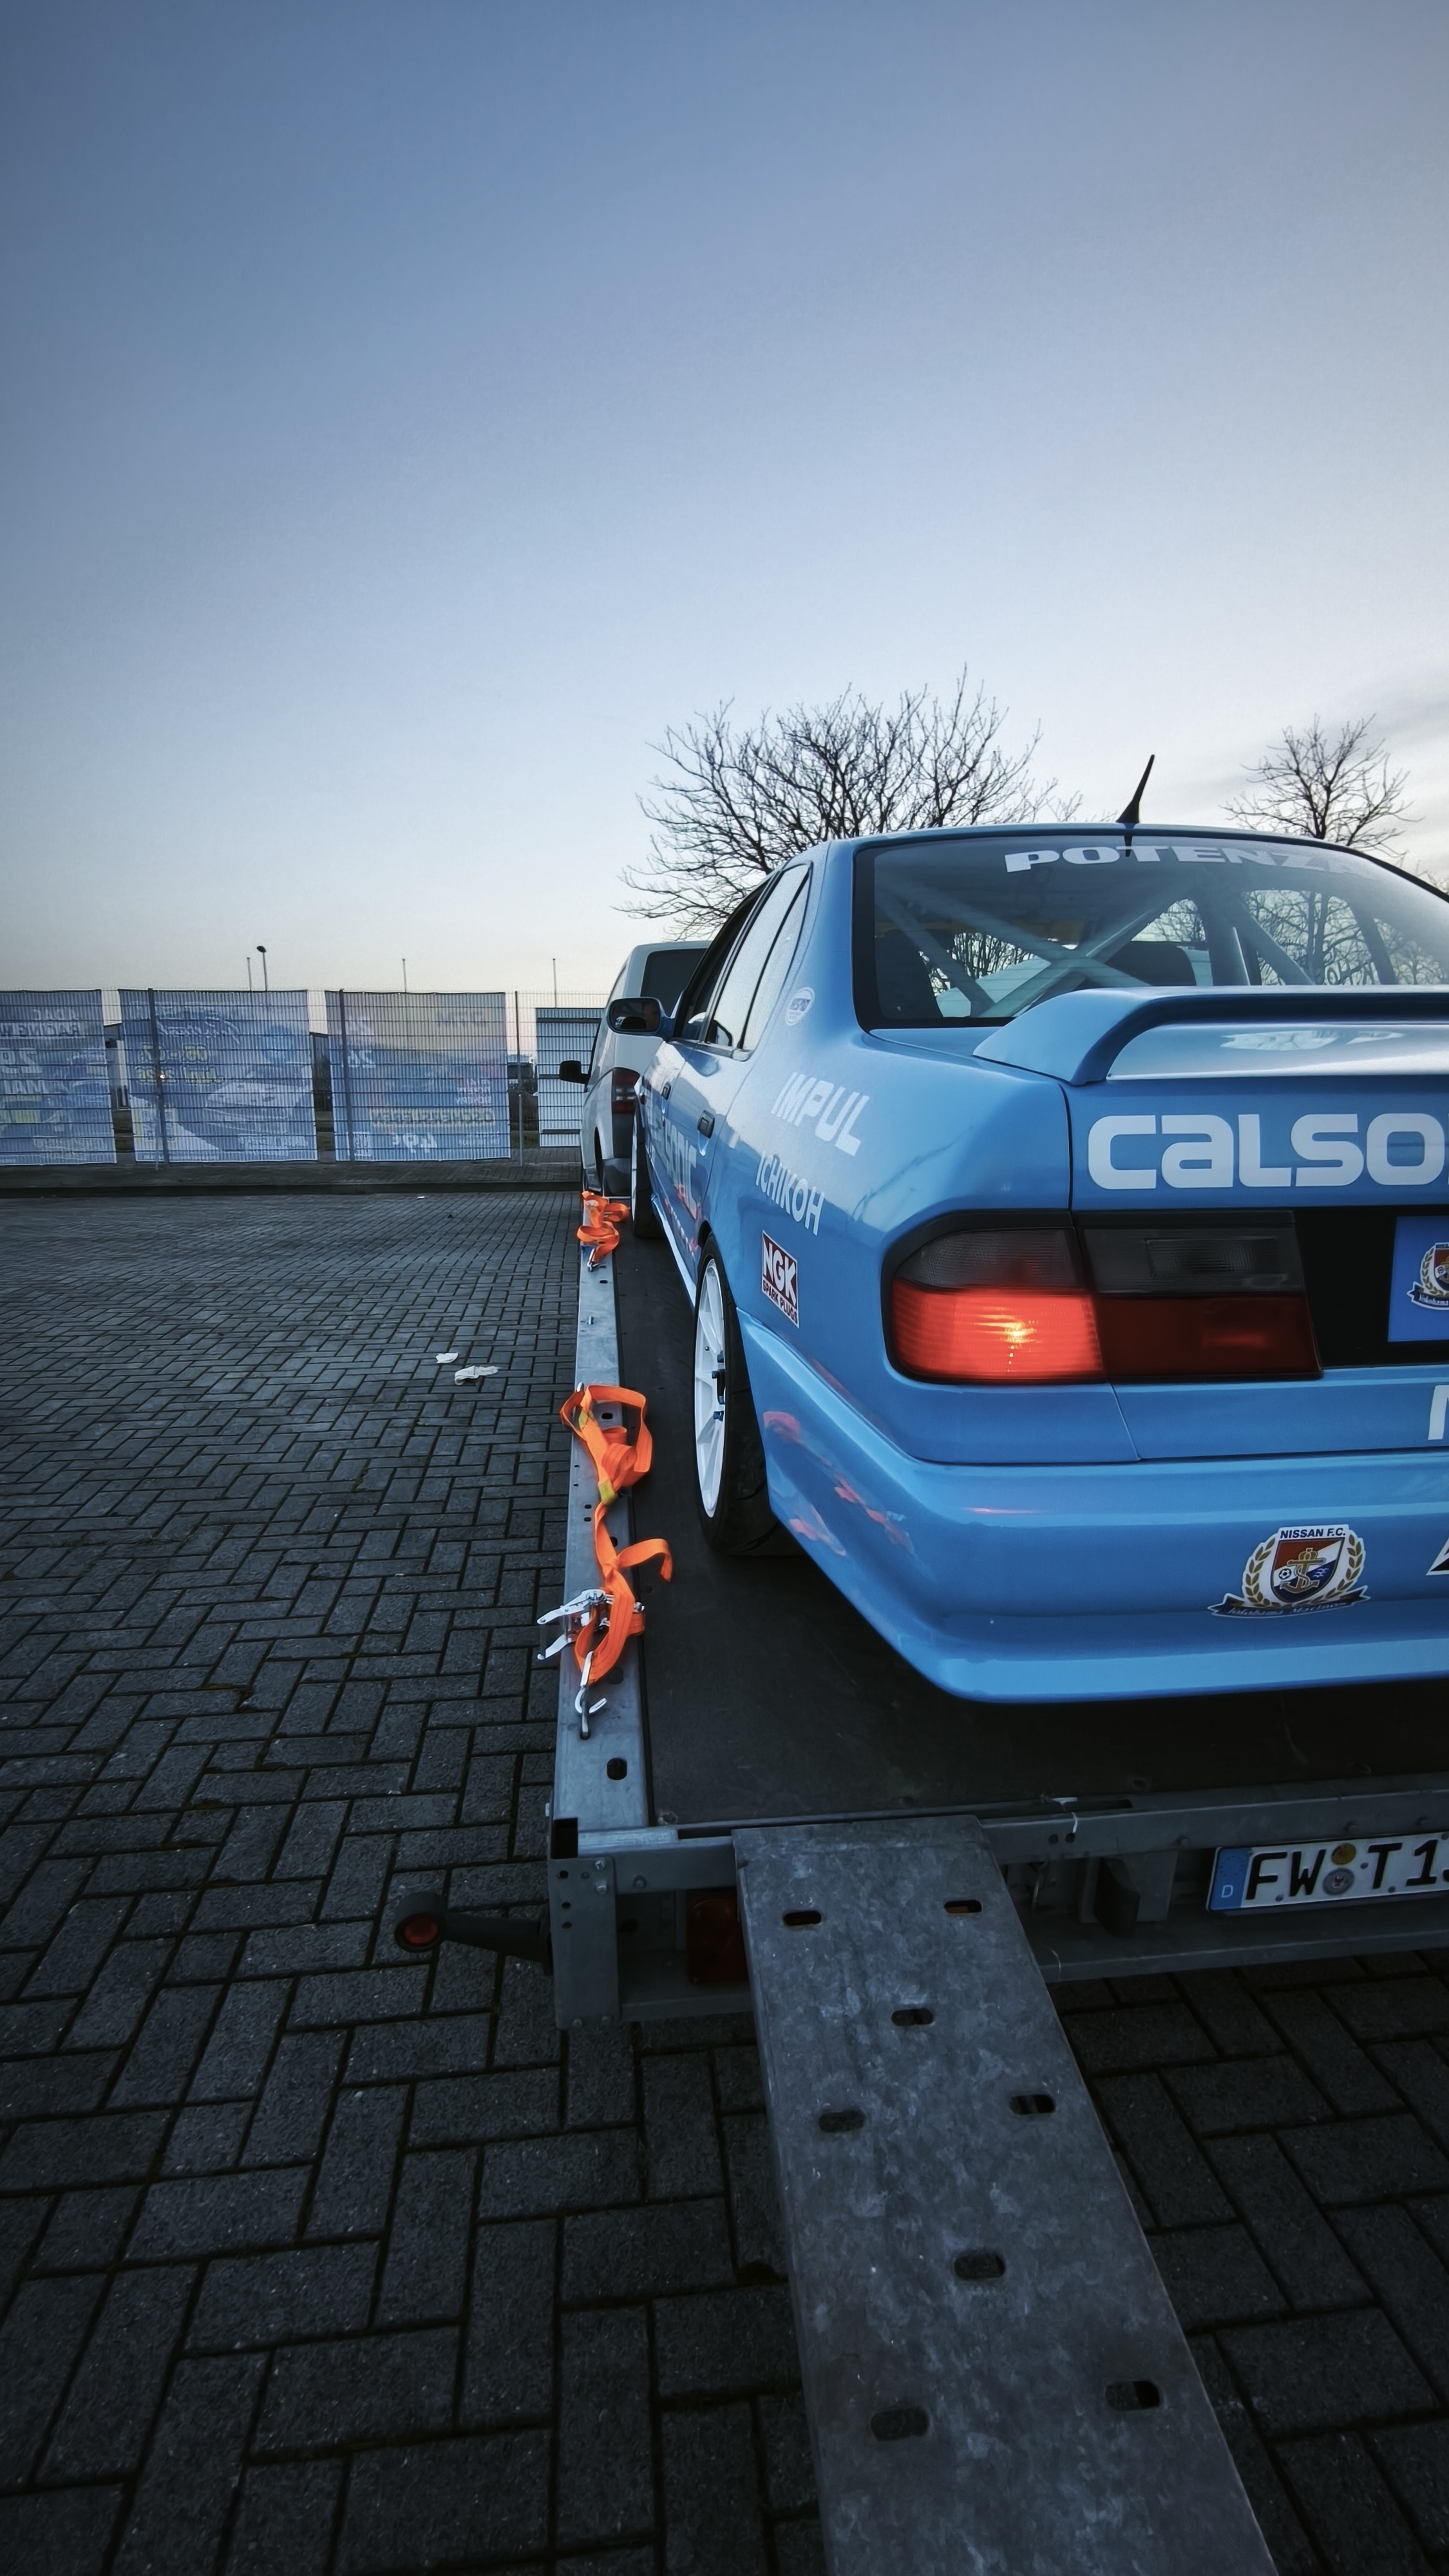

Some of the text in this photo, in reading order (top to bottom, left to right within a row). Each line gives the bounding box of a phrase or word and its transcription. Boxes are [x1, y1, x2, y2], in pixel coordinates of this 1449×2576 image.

[771, 1072, 869, 1157] IMPUL
[755, 1150, 826, 1236] ICHIKOH
[762, 1242, 797, 1305] NGK
[762, 1280, 798, 1324] SPARK PLUGS
[1280, 1527, 1346, 1539] NISSAN F.C.
[1221, 1884, 1233, 1898] D
